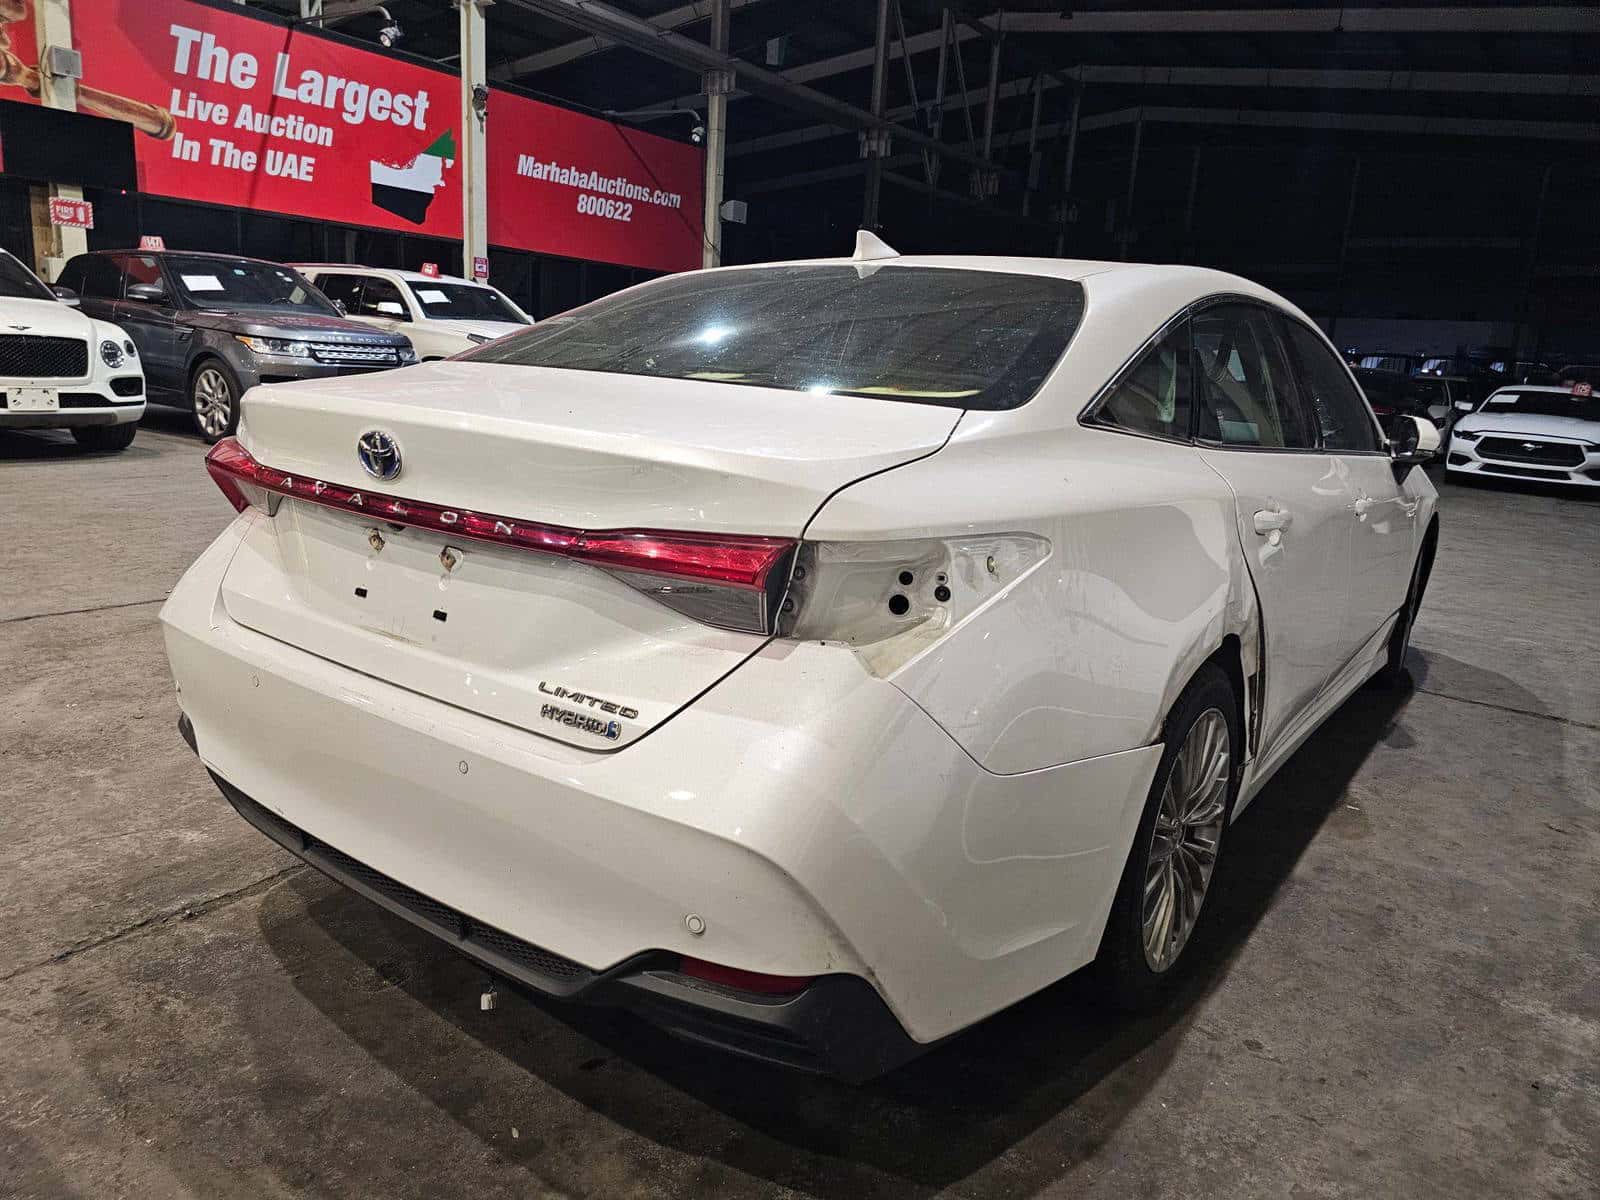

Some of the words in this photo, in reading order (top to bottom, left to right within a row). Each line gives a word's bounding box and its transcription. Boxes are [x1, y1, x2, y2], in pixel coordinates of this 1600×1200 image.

[169, 24, 258, 89] The
[272, 53, 429, 131] Largest
[170, 88, 229, 125] Live
[234, 104, 333, 147] Auction
[171, 133, 200, 162] In
[208, 138, 258, 172] The
[265, 150, 316, 182] UAE
[516, 153, 682, 209] MarhabaAuctions.com
[576, 193, 633, 222] 800622
[538, 681, 639, 719] LIMITED
[540, 703, 608, 736] HYBRID
